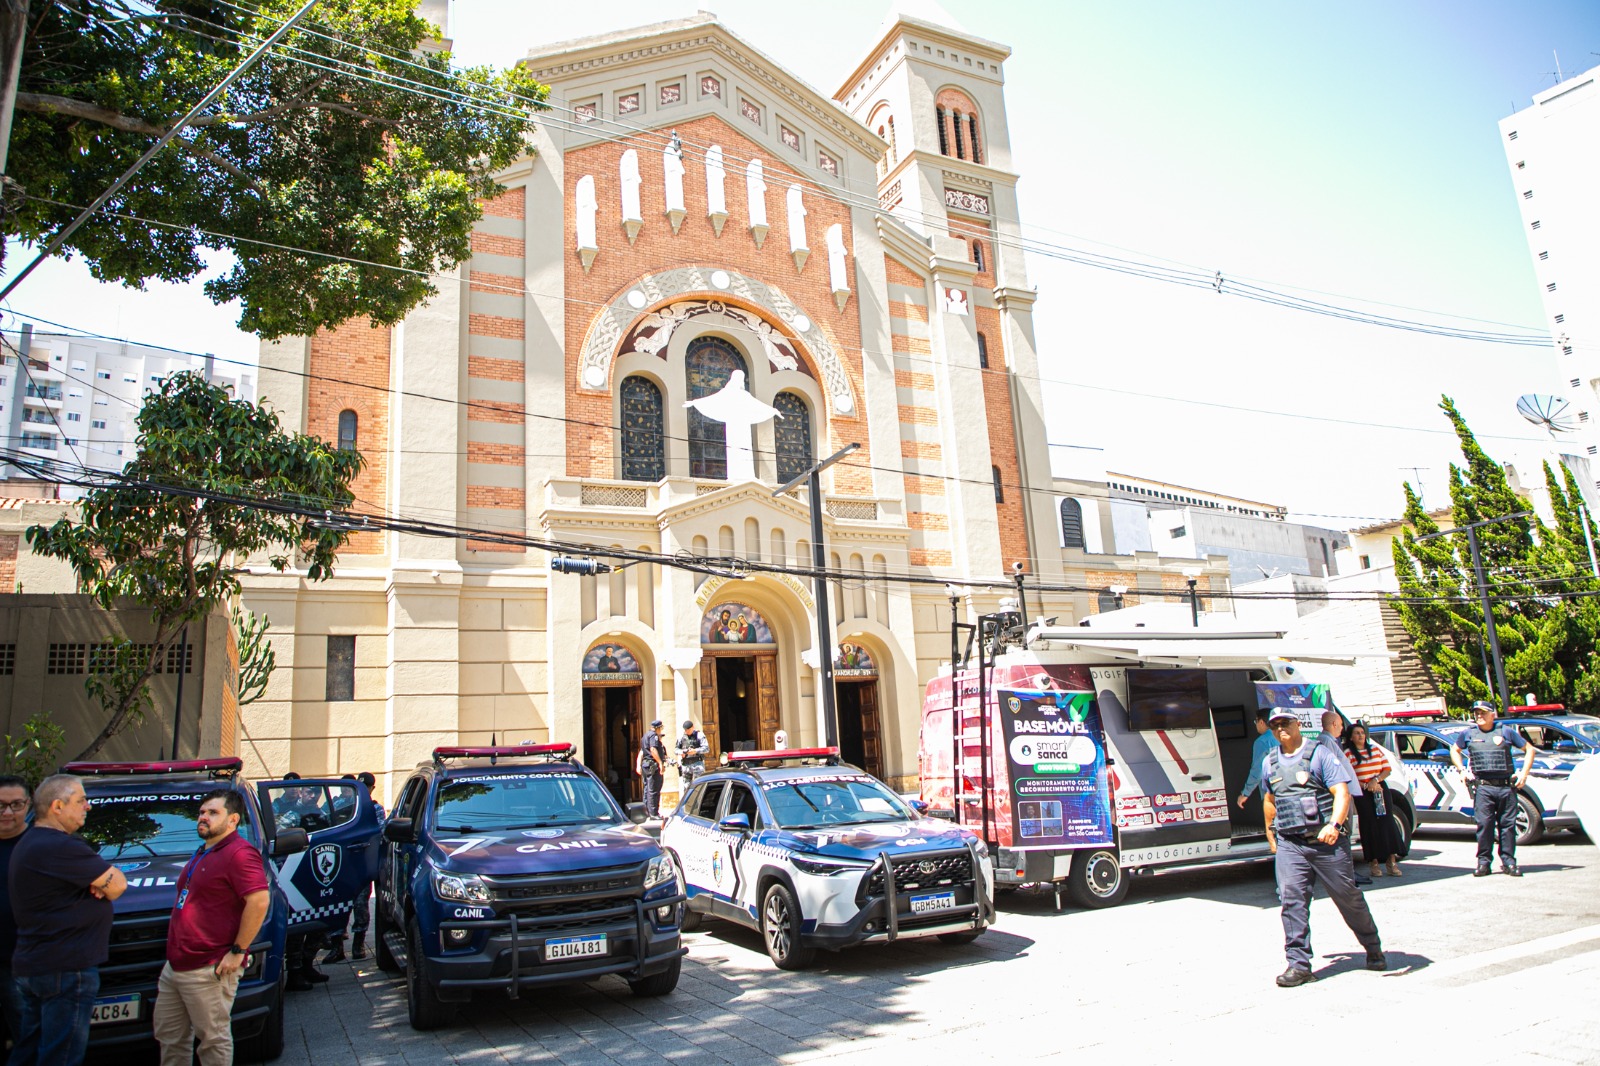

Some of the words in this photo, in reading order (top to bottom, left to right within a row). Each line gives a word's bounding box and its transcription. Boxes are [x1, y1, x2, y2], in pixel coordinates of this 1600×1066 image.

[1294, 711, 1311, 721] art
[1013, 719, 1046, 733] BASE
[1046, 717, 1089, 734] MÓVEL
[1299, 721, 1313, 729] nca
[1036, 740, 1068, 751] smart
[1037, 751, 1068, 760] sanca
[453, 774, 527, 784] POLICIAMENTO
[763, 781, 787, 791] SÃO
[788, 776, 838, 785] CAETANO
[315, 846, 336, 854] CANIL
[516, 839, 608, 854] CANIL
[1121, 846, 1201, 863] ECNOLÓGICA
[1207, 844, 1220, 853] DE
[320, 887, 334, 897] K-9
[915, 898, 951, 912] GBM5A41
[454, 908, 485, 918] CANIL
[551, 941, 601, 958] GIU4I81
[91, 1003, 130, 1021] 4C84
